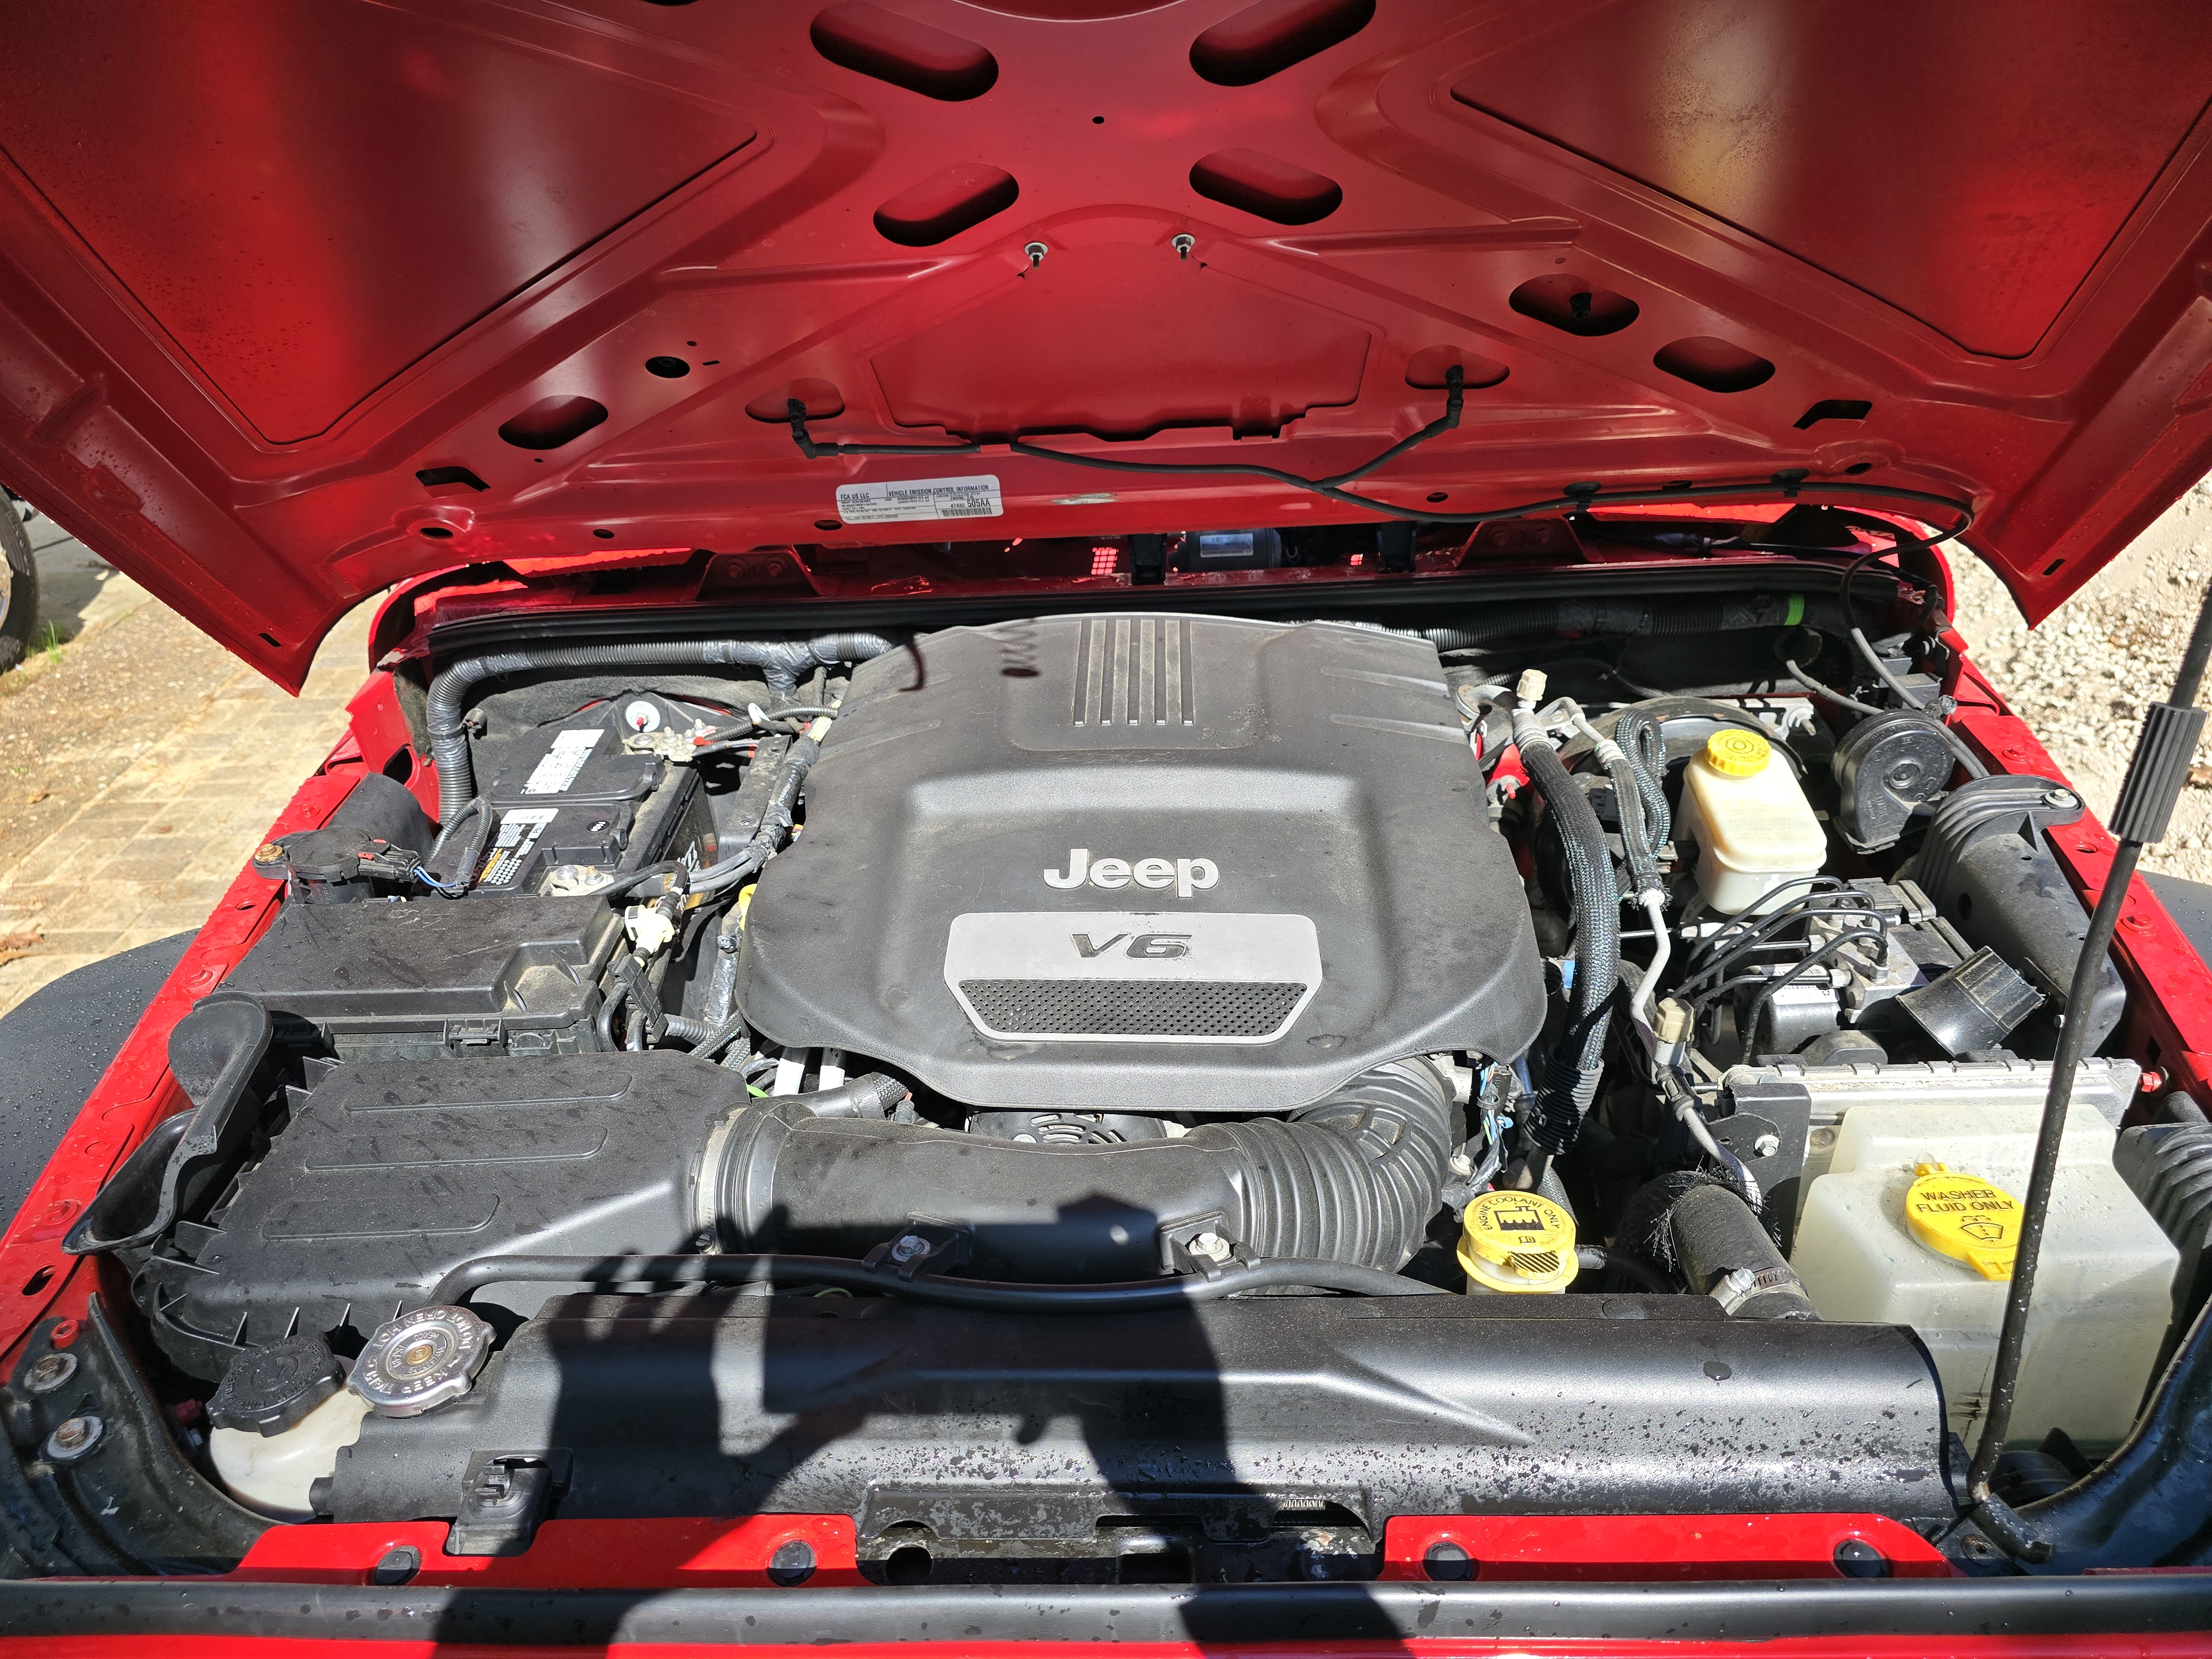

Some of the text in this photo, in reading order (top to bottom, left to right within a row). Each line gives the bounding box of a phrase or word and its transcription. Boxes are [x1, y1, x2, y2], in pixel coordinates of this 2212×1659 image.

[889, 488, 908, 497] VEHICLE
[909, 487, 932, 495] EMISSION
[967, 499, 990, 508] 505AA
[1044, 848, 1219, 899] Jeep
[1071, 933, 1192, 958] V6
[1921, 1190, 1997, 1200] WASHER
[1917, 1201, 2014, 1212] FLUID ONLY
[1478, 1196, 1561, 1231] ENGINE COOLANT ONLY
